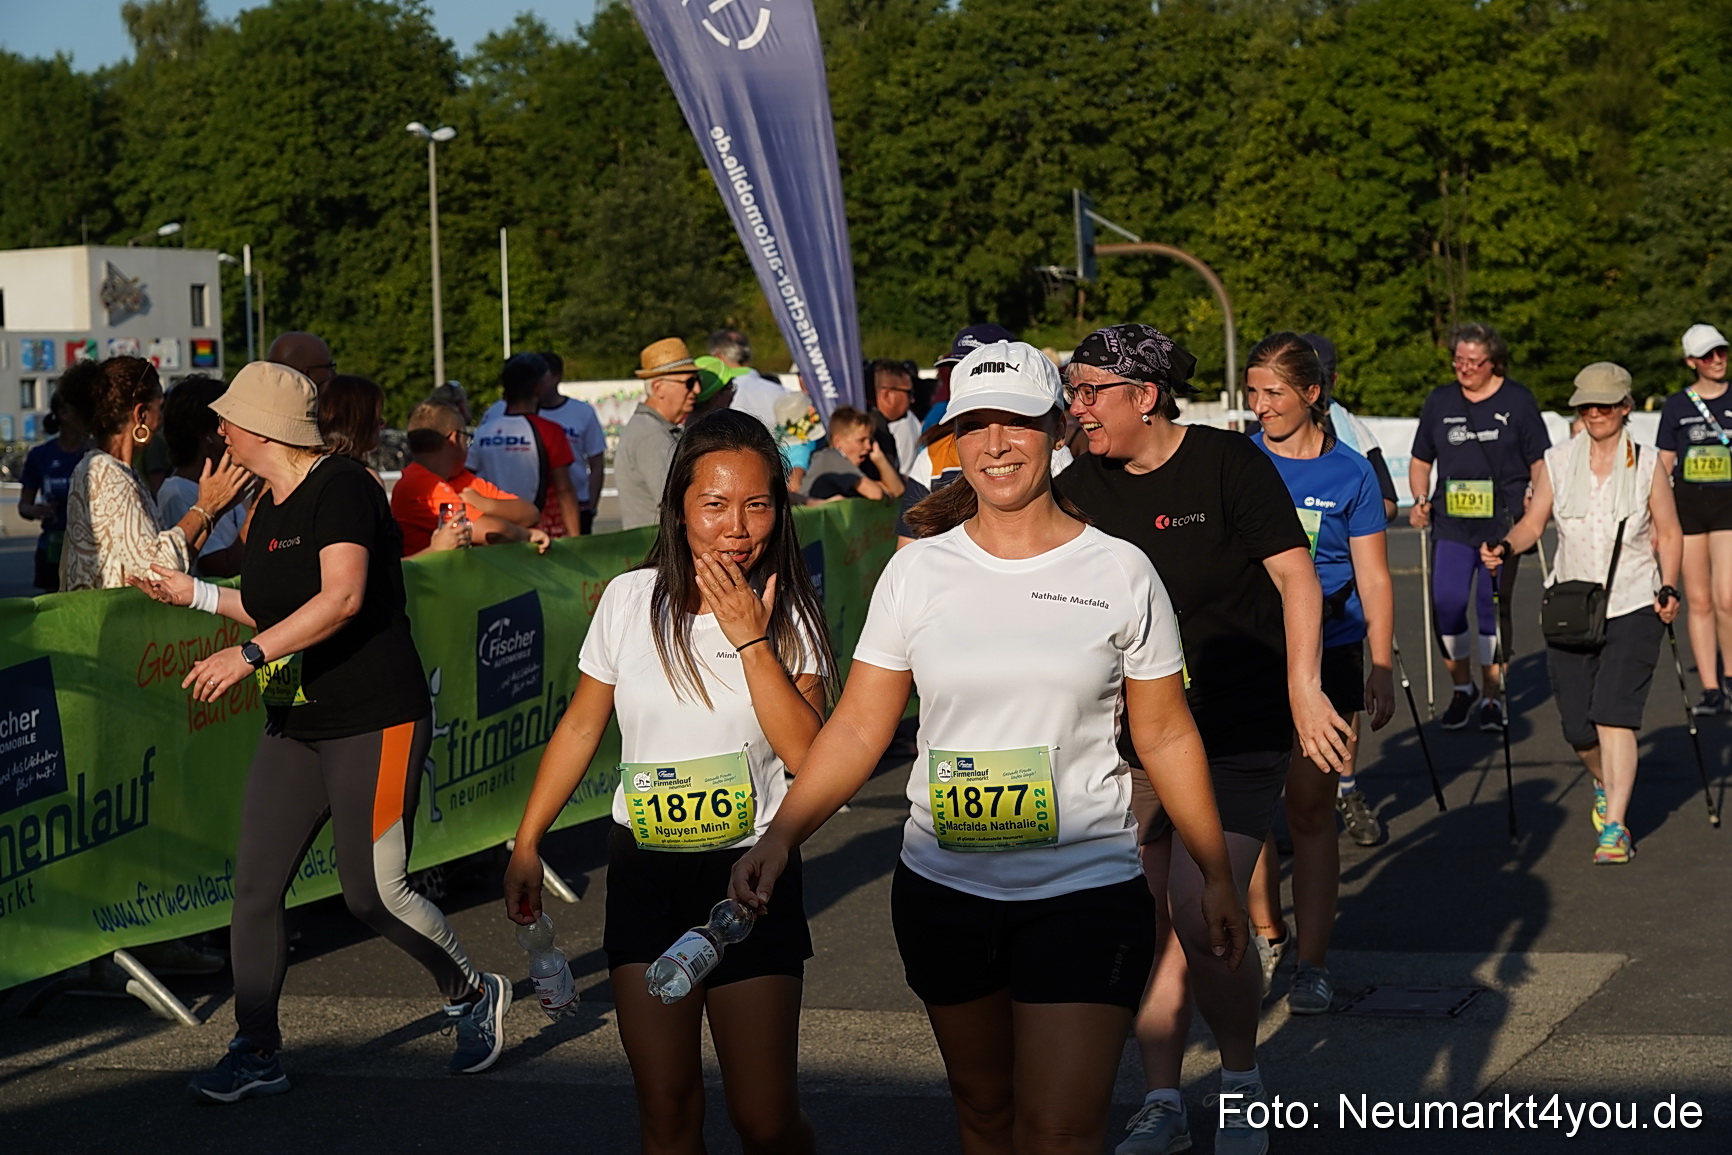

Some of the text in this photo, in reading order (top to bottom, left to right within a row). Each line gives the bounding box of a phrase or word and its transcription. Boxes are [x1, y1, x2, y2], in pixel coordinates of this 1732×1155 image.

[970, 362, 1005, 377] PUMA
[1694, 458, 1724, 470] 1787
[1454, 493, 1484, 505] 1791
[1172, 513, 1205, 527] ECOVIS
[1031, 591, 1110, 610] Nathalie Macfalda
[489, 630, 536, 659] Fischer
[716, 651, 738, 659] Minh
[448, 681, 571, 782] firmenla
[653, 776, 692, 787] Firmenlauf
[953, 769, 989, 778] Firmenlauf
[450, 768, 516, 809] neumarkt
[647, 788, 733, 823] 1876
[735, 790, 749, 830] 2022
[947, 784, 1028, 818] 1877
[1034, 787, 1049, 832] 2022
[632, 798, 650, 839] WALK
[935, 789, 947, 836] WALK
[655, 821, 730, 837] Nguyen Minh
[945, 819, 1037, 832] Macfalda Nathalie
